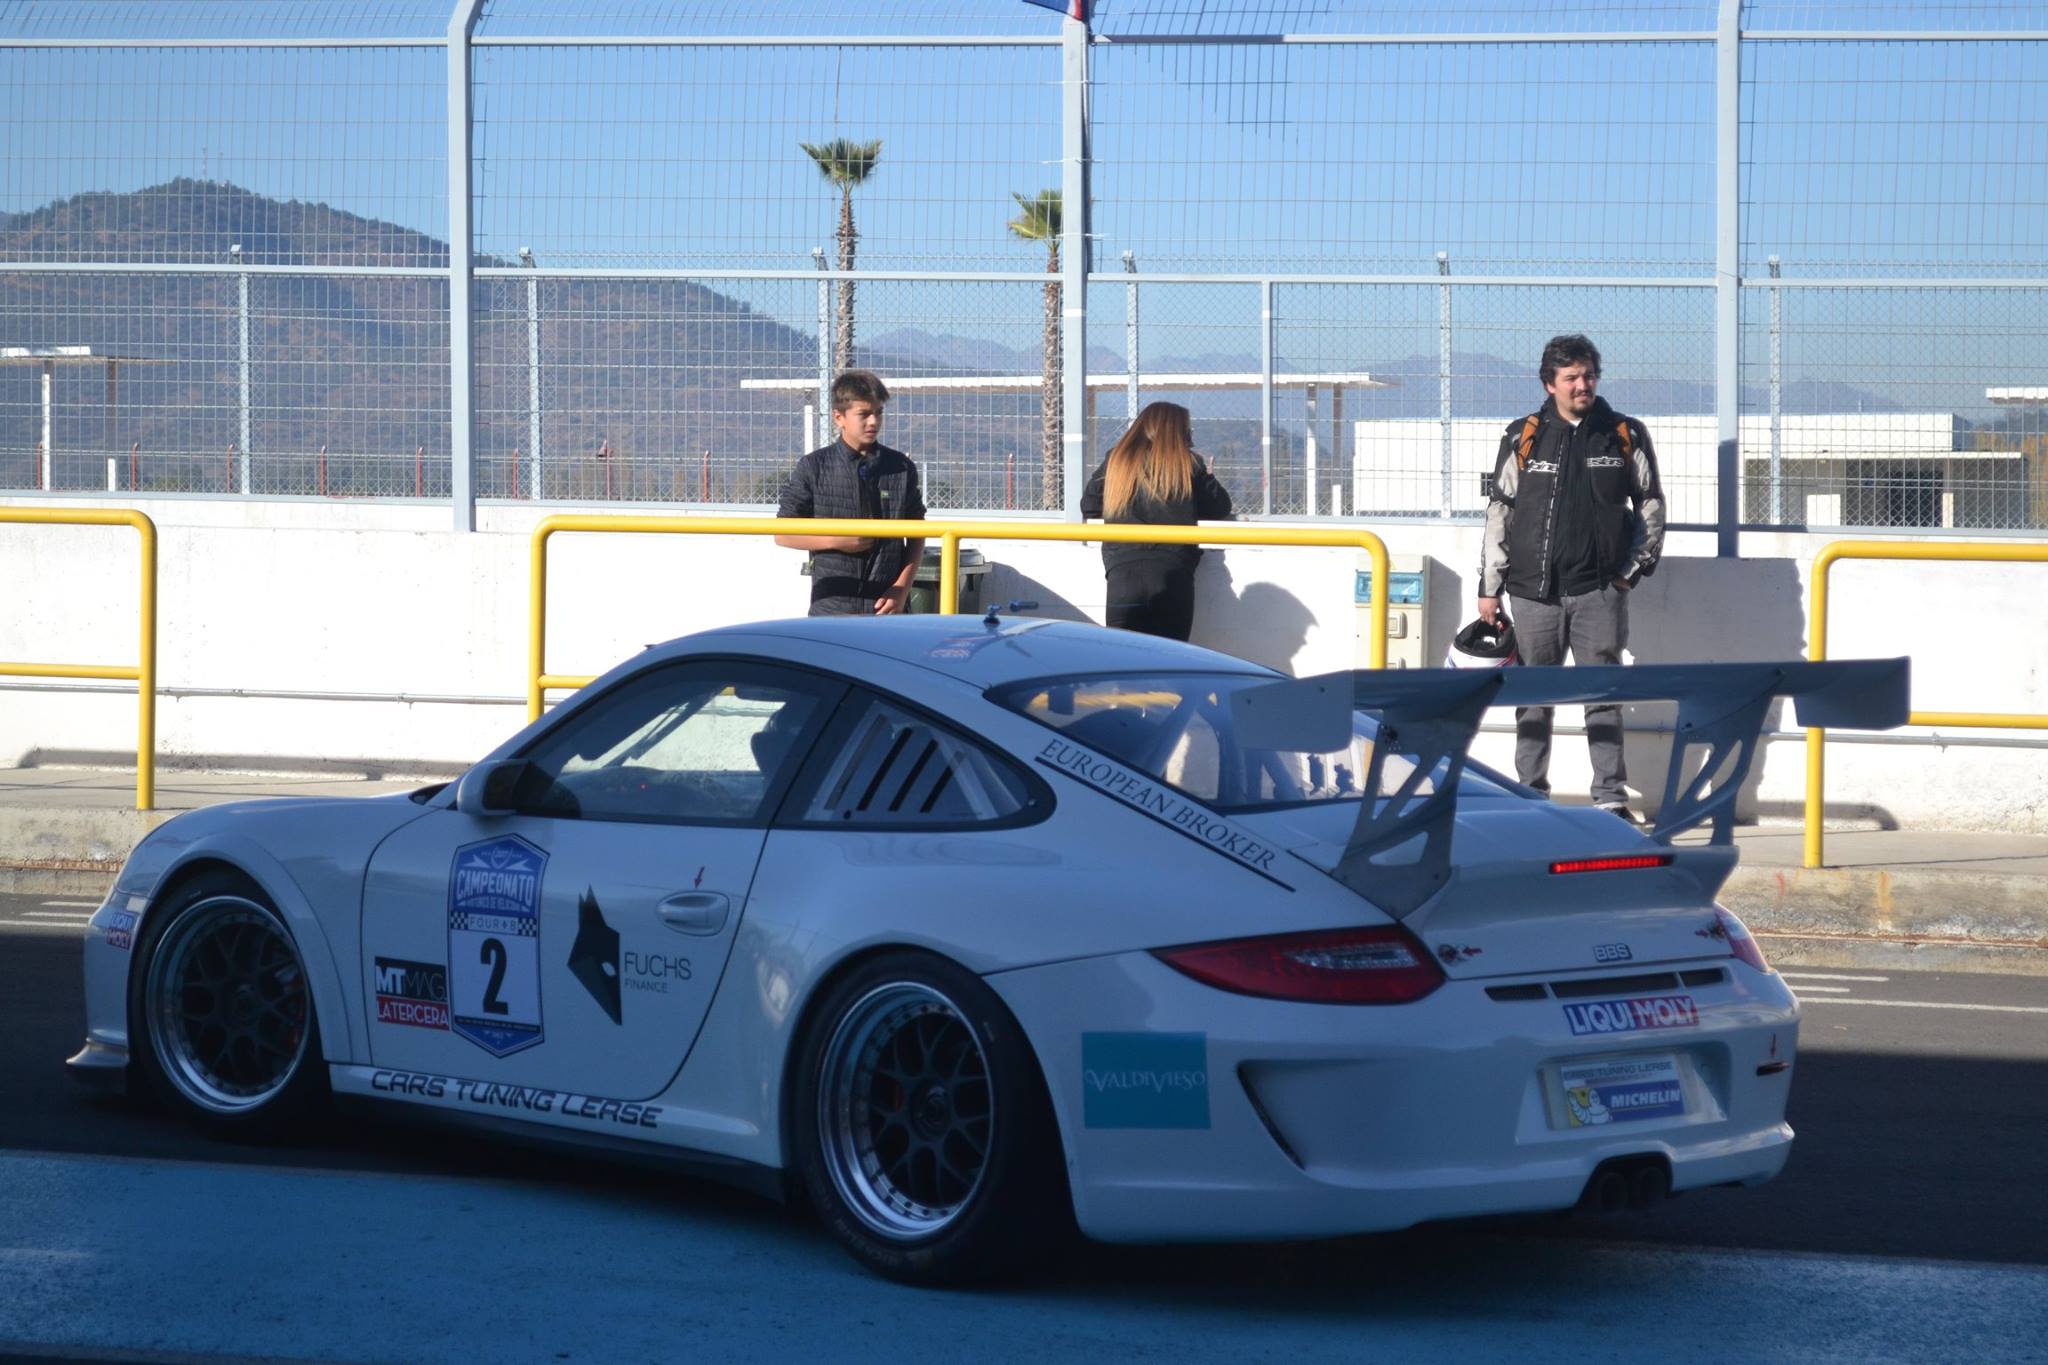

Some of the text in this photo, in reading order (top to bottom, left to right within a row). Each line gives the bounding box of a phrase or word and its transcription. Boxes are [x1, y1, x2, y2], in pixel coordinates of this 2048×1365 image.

[1040, 738, 1276, 870] EUROPEAN BROKER
[456, 869, 535, 907] CAMPEONATO
[624, 951, 692, 980] FUCHS
[1594, 944, 1630, 960] BBS
[480, 937, 509, 1015] 2
[624, 978, 669, 994] FINANCE
[1565, 998, 1696, 1034] LIQUI MOLY
[371, 1070, 664, 1128] CARS TUNING LEASE
[1610, 1089, 1681, 1108] MICHELIN
